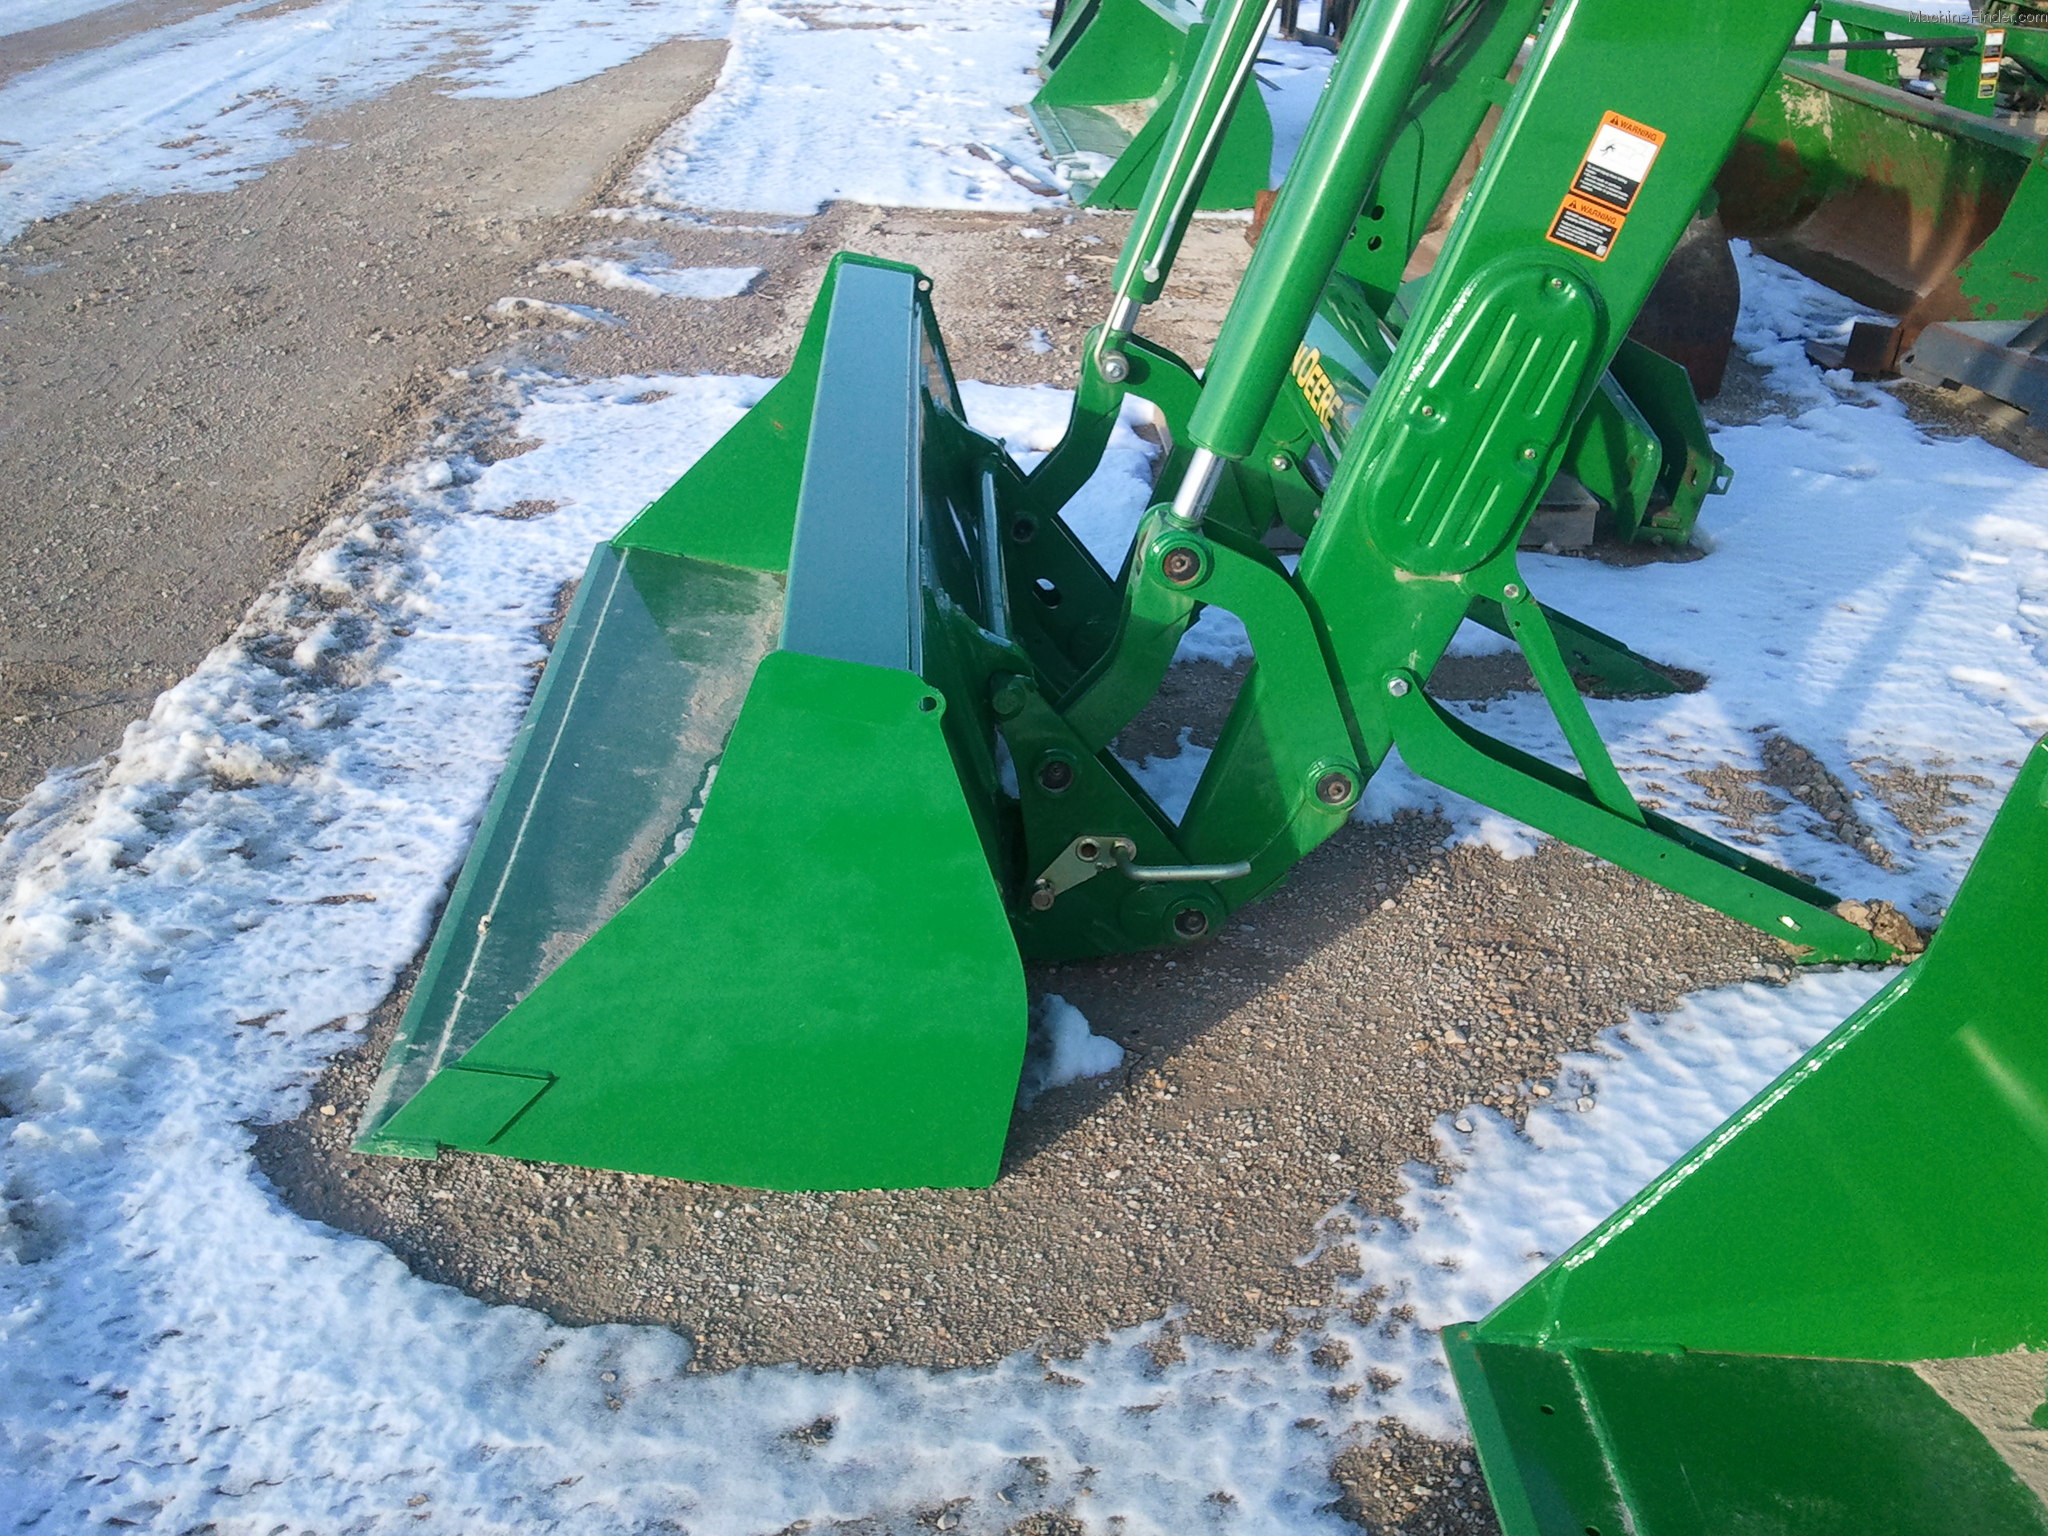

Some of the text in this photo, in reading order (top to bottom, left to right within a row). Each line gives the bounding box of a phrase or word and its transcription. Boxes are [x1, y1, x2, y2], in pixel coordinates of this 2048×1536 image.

[1620, 121, 1656, 142] WARNING
[1580, 204, 1616, 225] WARNING
[1296, 347, 1344, 432] DEERE
